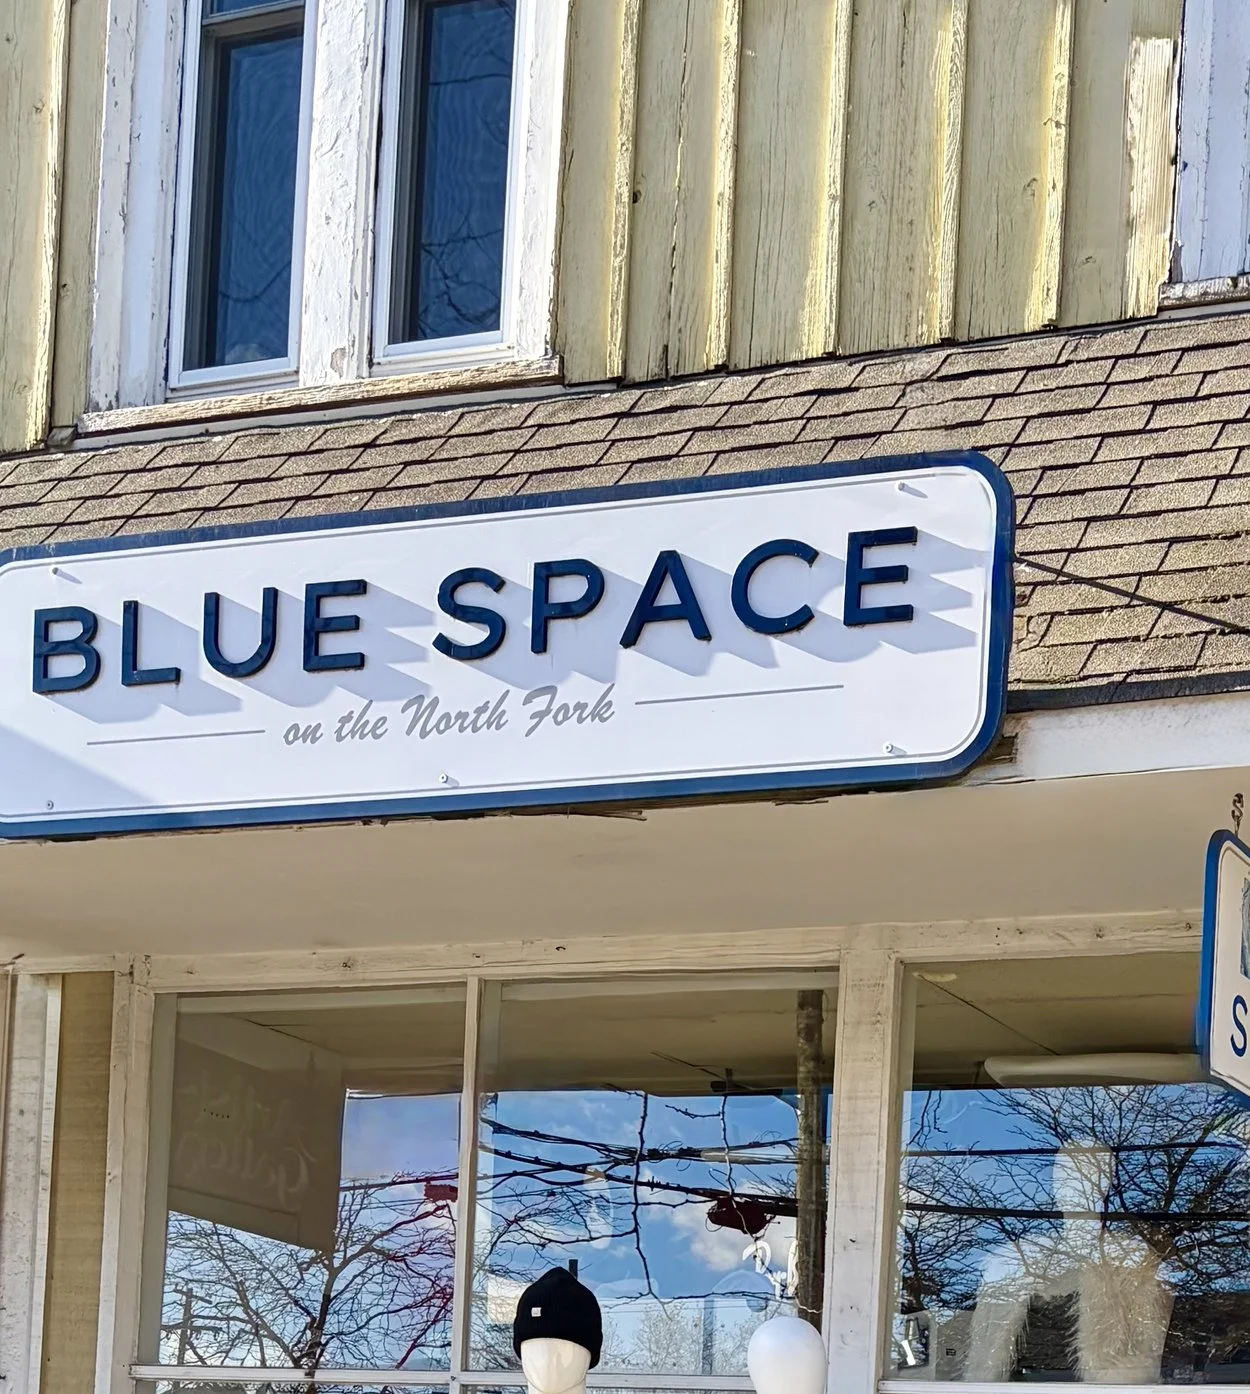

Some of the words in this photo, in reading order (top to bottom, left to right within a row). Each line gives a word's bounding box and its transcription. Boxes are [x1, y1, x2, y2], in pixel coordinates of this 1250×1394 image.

[33, 578, 368, 695] BLUE
[431, 525, 918, 662] SPACE
[283, 721, 324, 746] on
[334, 699, 389, 743] the
[400, 690, 511, 740] North
[522, 683, 616, 738] Fork
